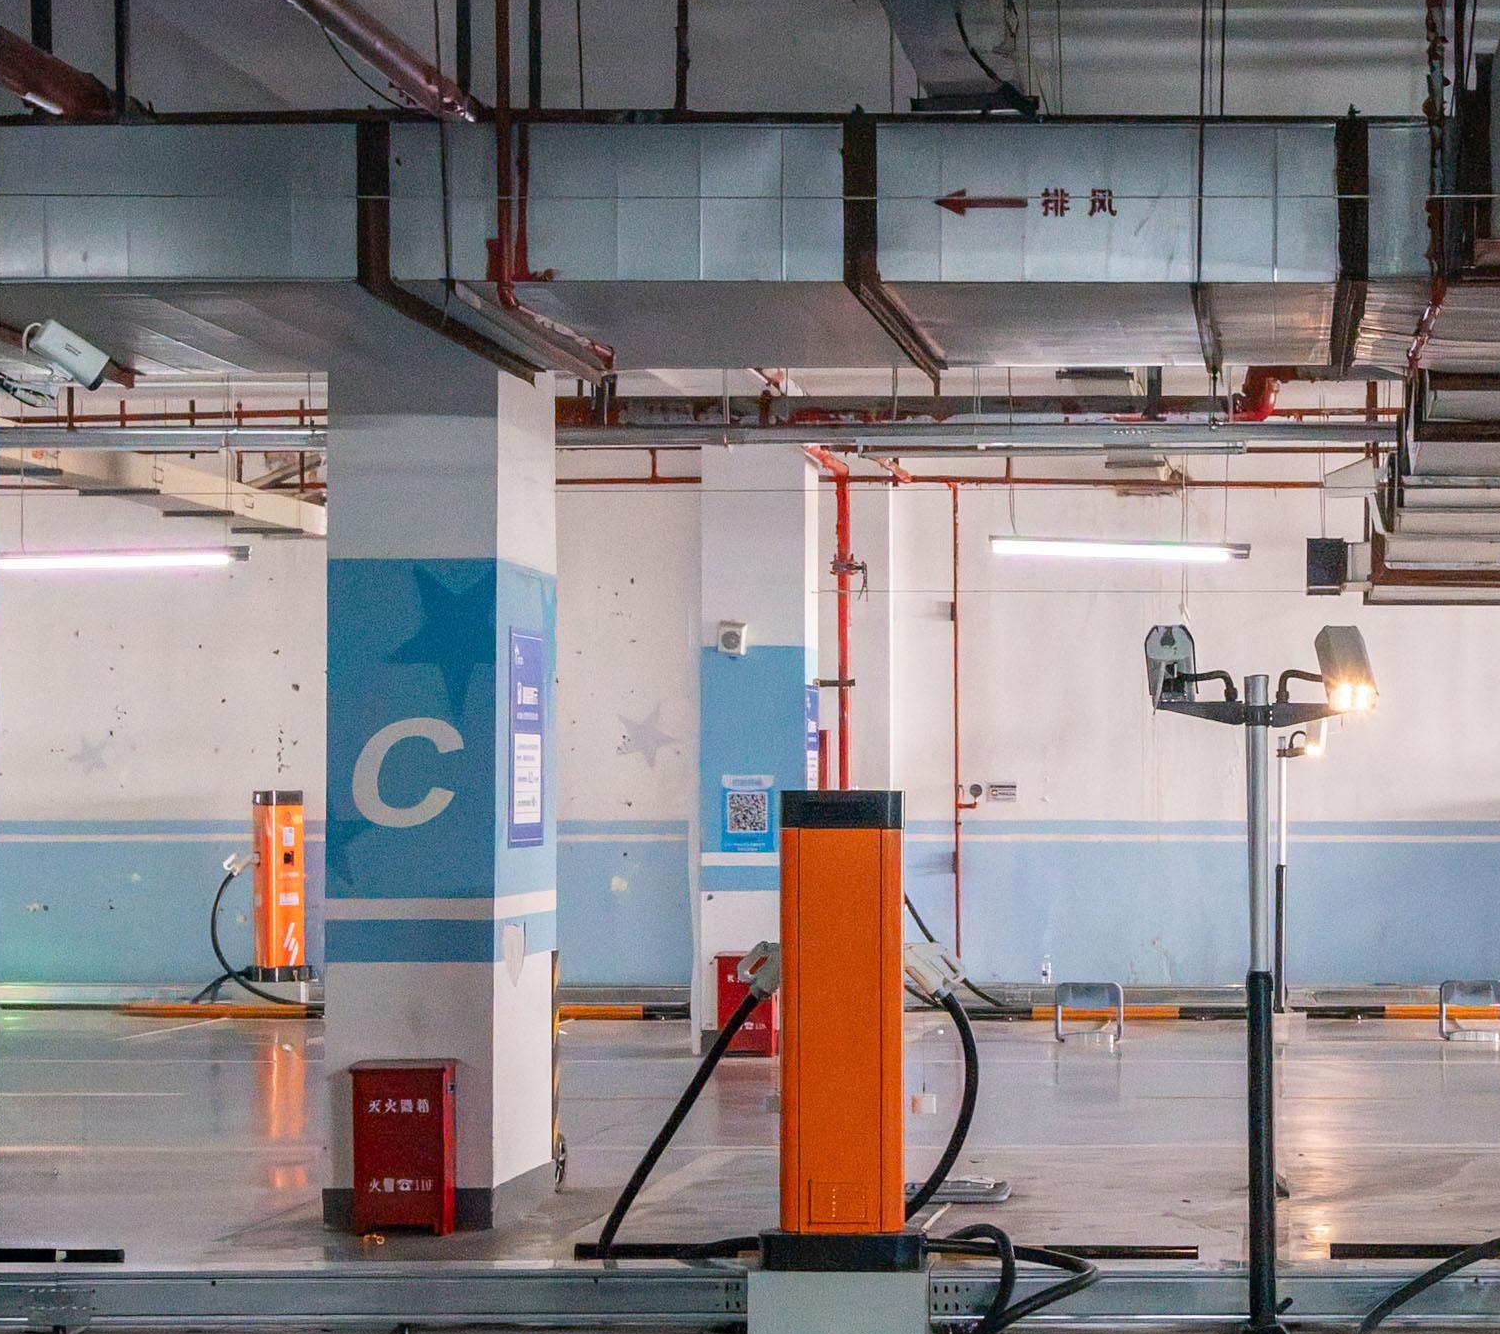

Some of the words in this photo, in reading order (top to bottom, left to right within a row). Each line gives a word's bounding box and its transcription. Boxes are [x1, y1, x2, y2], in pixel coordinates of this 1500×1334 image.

[351, 717, 465, 828] C
[367, 1098, 430, 1114] 灭火器箱
